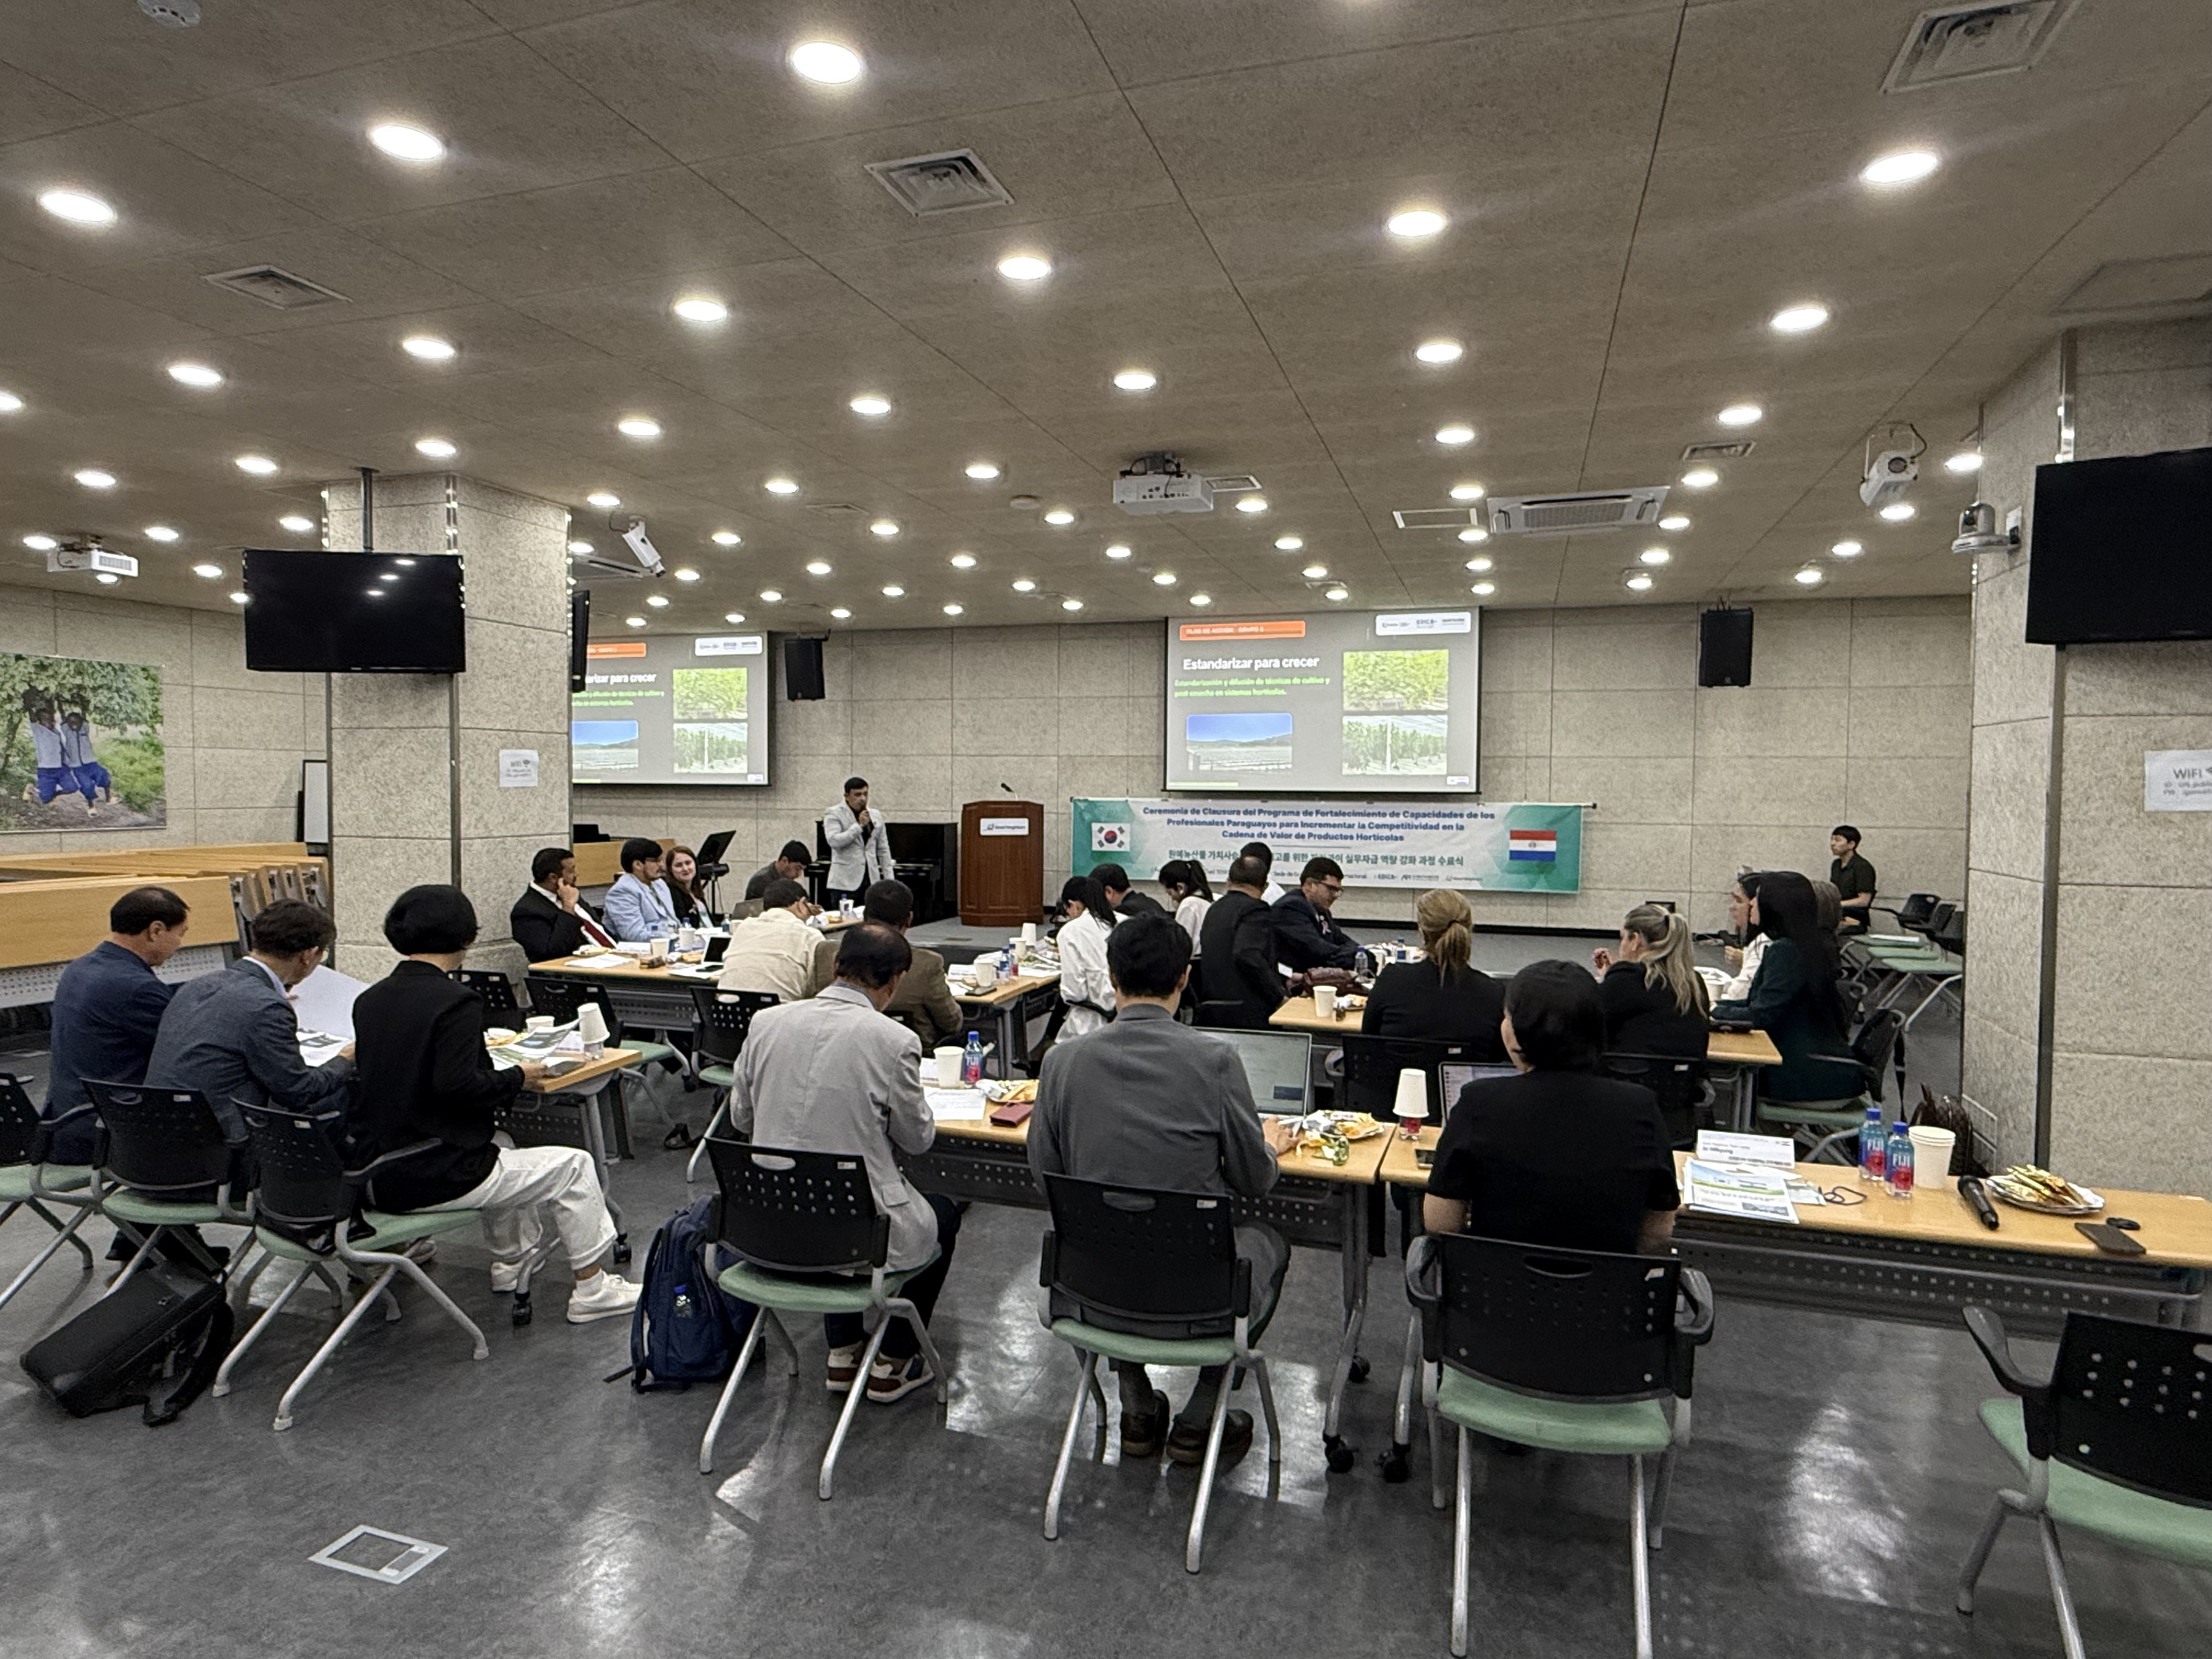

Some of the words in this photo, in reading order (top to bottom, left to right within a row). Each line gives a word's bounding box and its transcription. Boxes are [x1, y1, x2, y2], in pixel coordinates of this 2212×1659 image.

[1183, 658, 1252, 670] Estandarizar
[1255, 659, 1280, 671] para
[1282, 657, 1320, 668] crecer
[610, 675, 629, 685] para
[630, 674, 657, 682] crecer
[2173, 768, 2202, 779] WIFI
[1203, 808, 1241, 816] Clausura
[1257, 809, 1300, 817] Programa
[1316, 809, 1387, 818] Fortalecimiento
[1402, 810, 1464, 820] Capacidades
[1480, 811, 1495, 820] los
[1227, 819, 1277, 828] Paraguayos
[1279, 821, 1299, 830] para
[1301, 821, 1355, 829] Incrementar
[1368, 822, 1440, 831] Competitividad
[1222, 830, 1255, 838] Cadena
[1307, 832, 1354, 840] Productos
[1356, 833, 1404, 842] Hortícolas
[1293, 853, 1309, 862] 위한
[1345, 854, 1378, 865] 실무자급
[1380, 854, 1398, 865] 역량
[1400, 855, 1417, 866] 강화
[1418, 855, 1436, 866] 과정
[1437, 855, 1464, 866] 수료식
[1867, 1138, 1884, 1152] FIJI
[1893, 1153, 1910, 1167] FIJI
